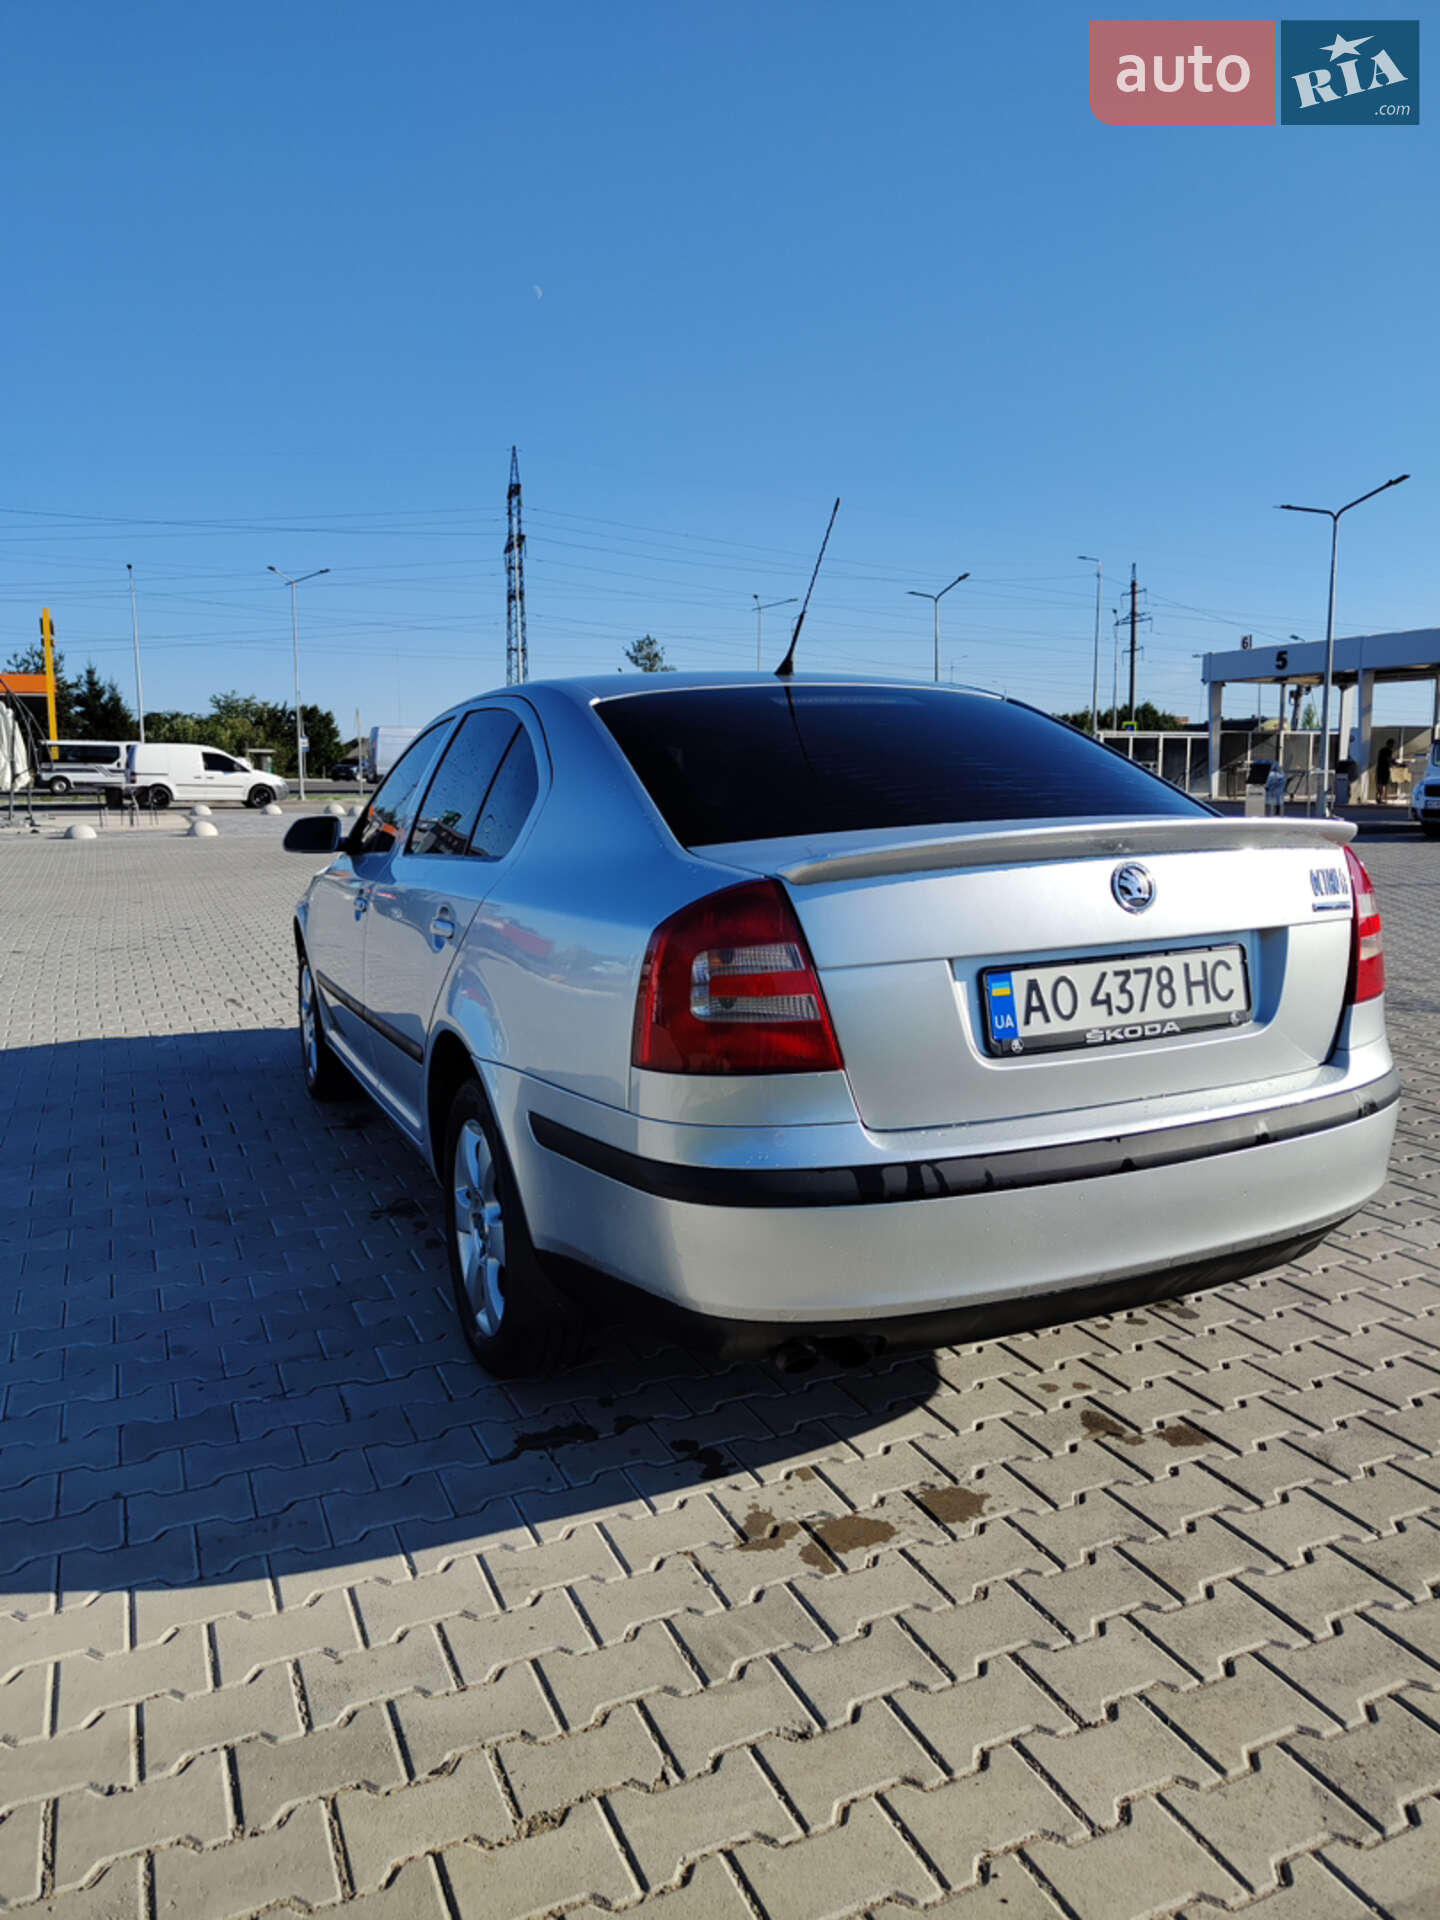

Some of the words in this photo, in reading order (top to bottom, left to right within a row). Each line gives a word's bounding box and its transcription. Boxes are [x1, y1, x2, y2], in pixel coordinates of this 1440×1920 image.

[1275, 650, 1288, 670] 5
[1023, 975, 1078, 1026] AO
[1090, 966, 1177, 1016] 4378
[1184, 960, 1235, 1006] HC
[995, 1015, 1014, 1029] UA
